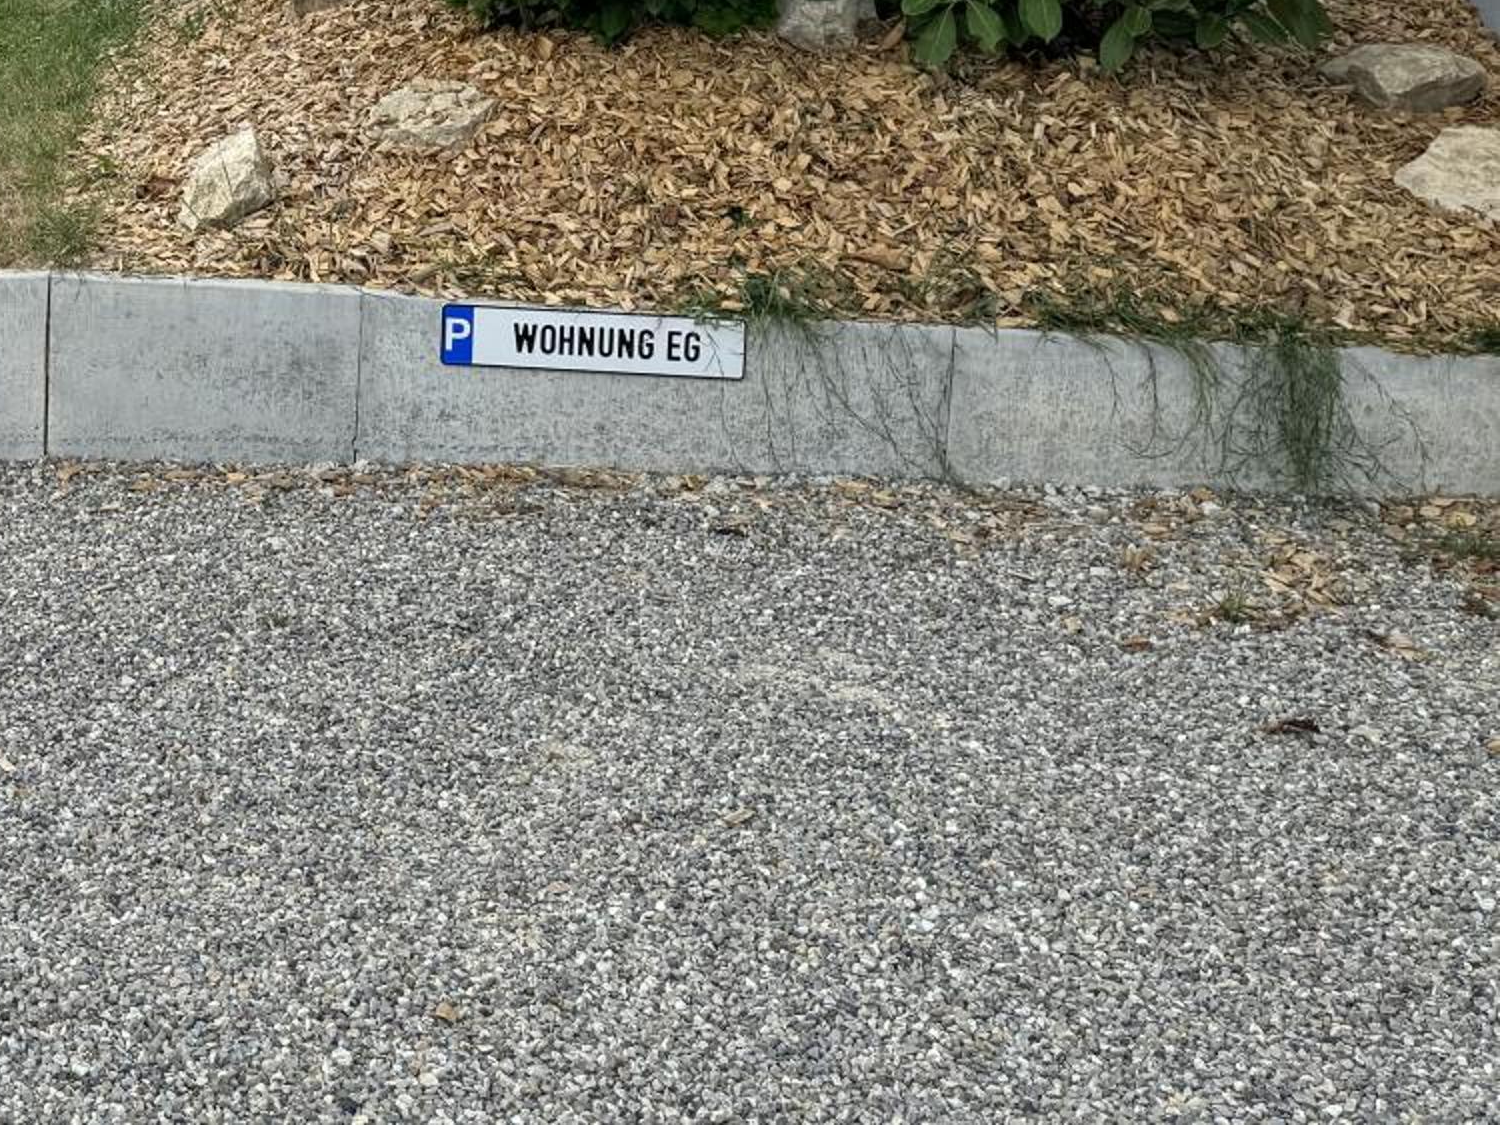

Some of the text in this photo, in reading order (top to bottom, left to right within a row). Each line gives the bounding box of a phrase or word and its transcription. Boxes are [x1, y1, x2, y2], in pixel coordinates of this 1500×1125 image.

[445, 317, 701, 362] P WOHNUNG EG
